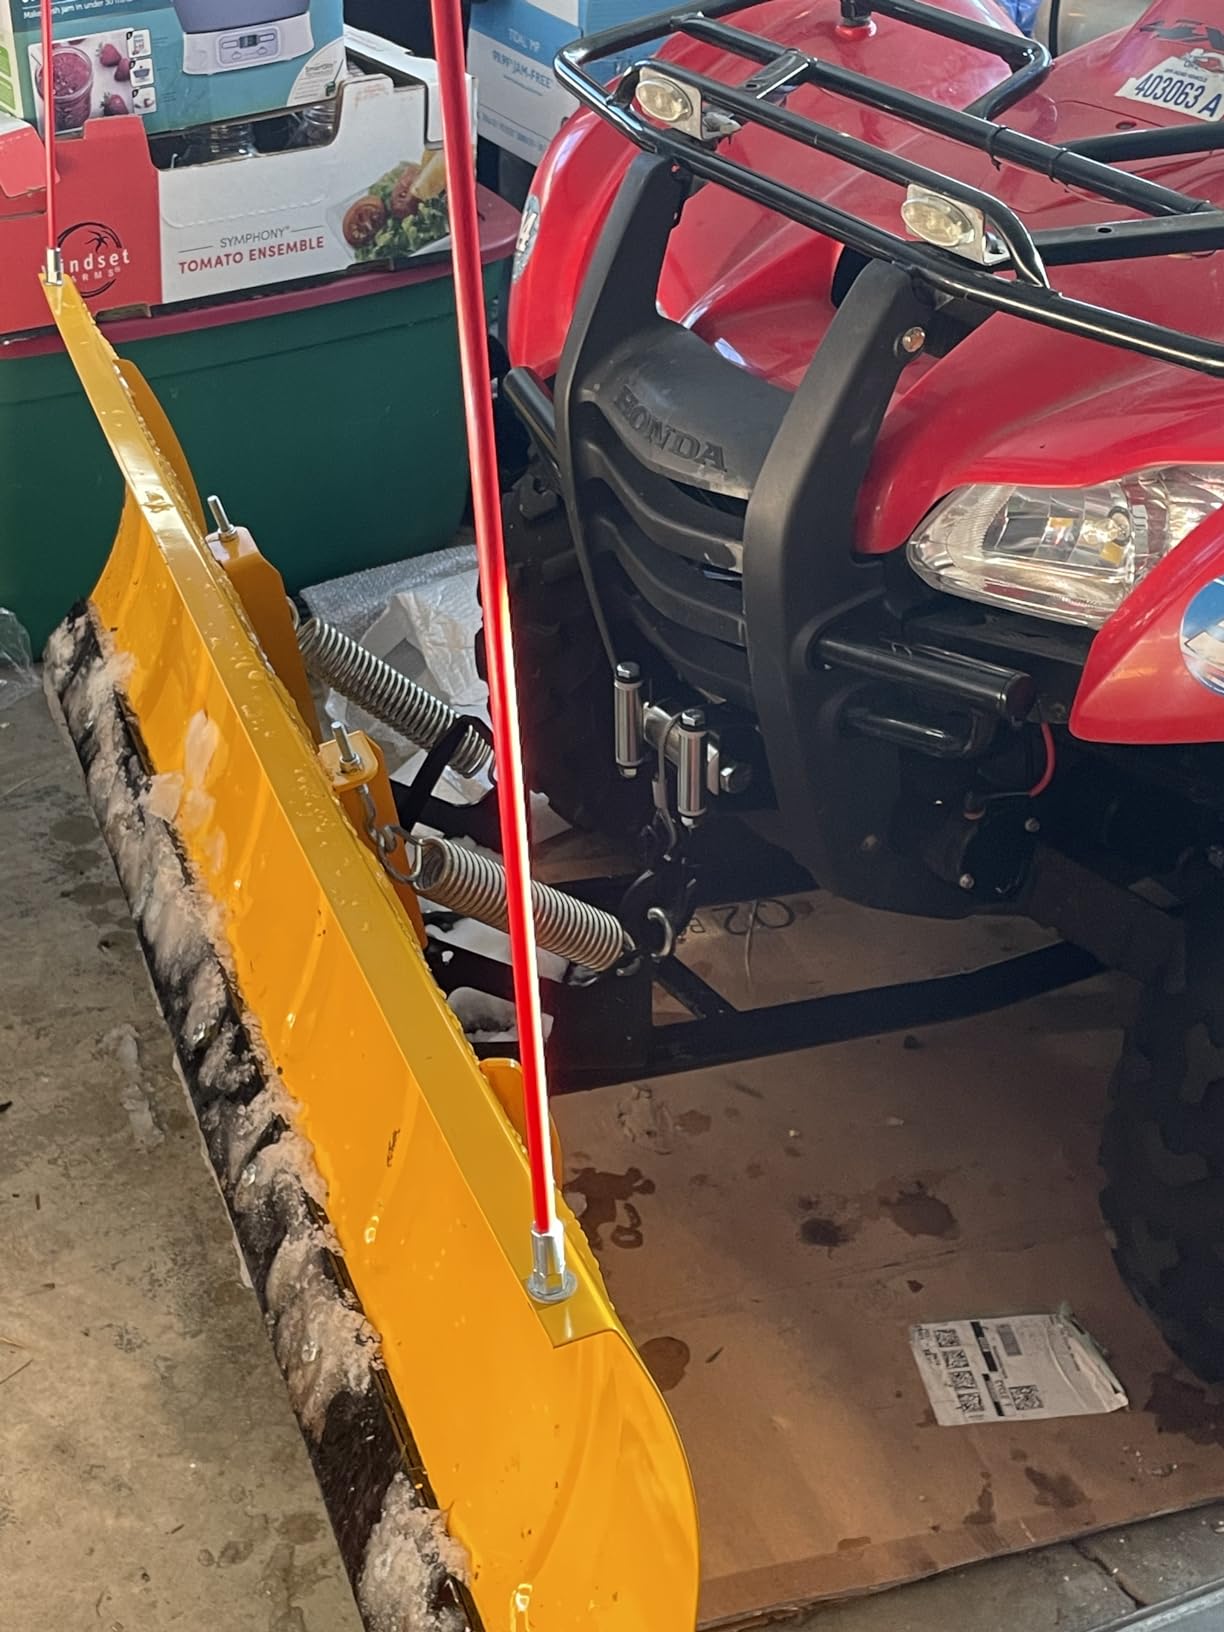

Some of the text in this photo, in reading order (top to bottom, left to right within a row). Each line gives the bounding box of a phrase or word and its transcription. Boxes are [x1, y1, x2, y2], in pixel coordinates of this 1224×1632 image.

[1134, 73, 1206, 109] 403063
[1197, 93, 1222, 118] A
[42, 248, 130, 279] indset
[178, 236, 325, 274] TOMATO ENSEMBLE
[613, 383, 728, 473] HONDA
